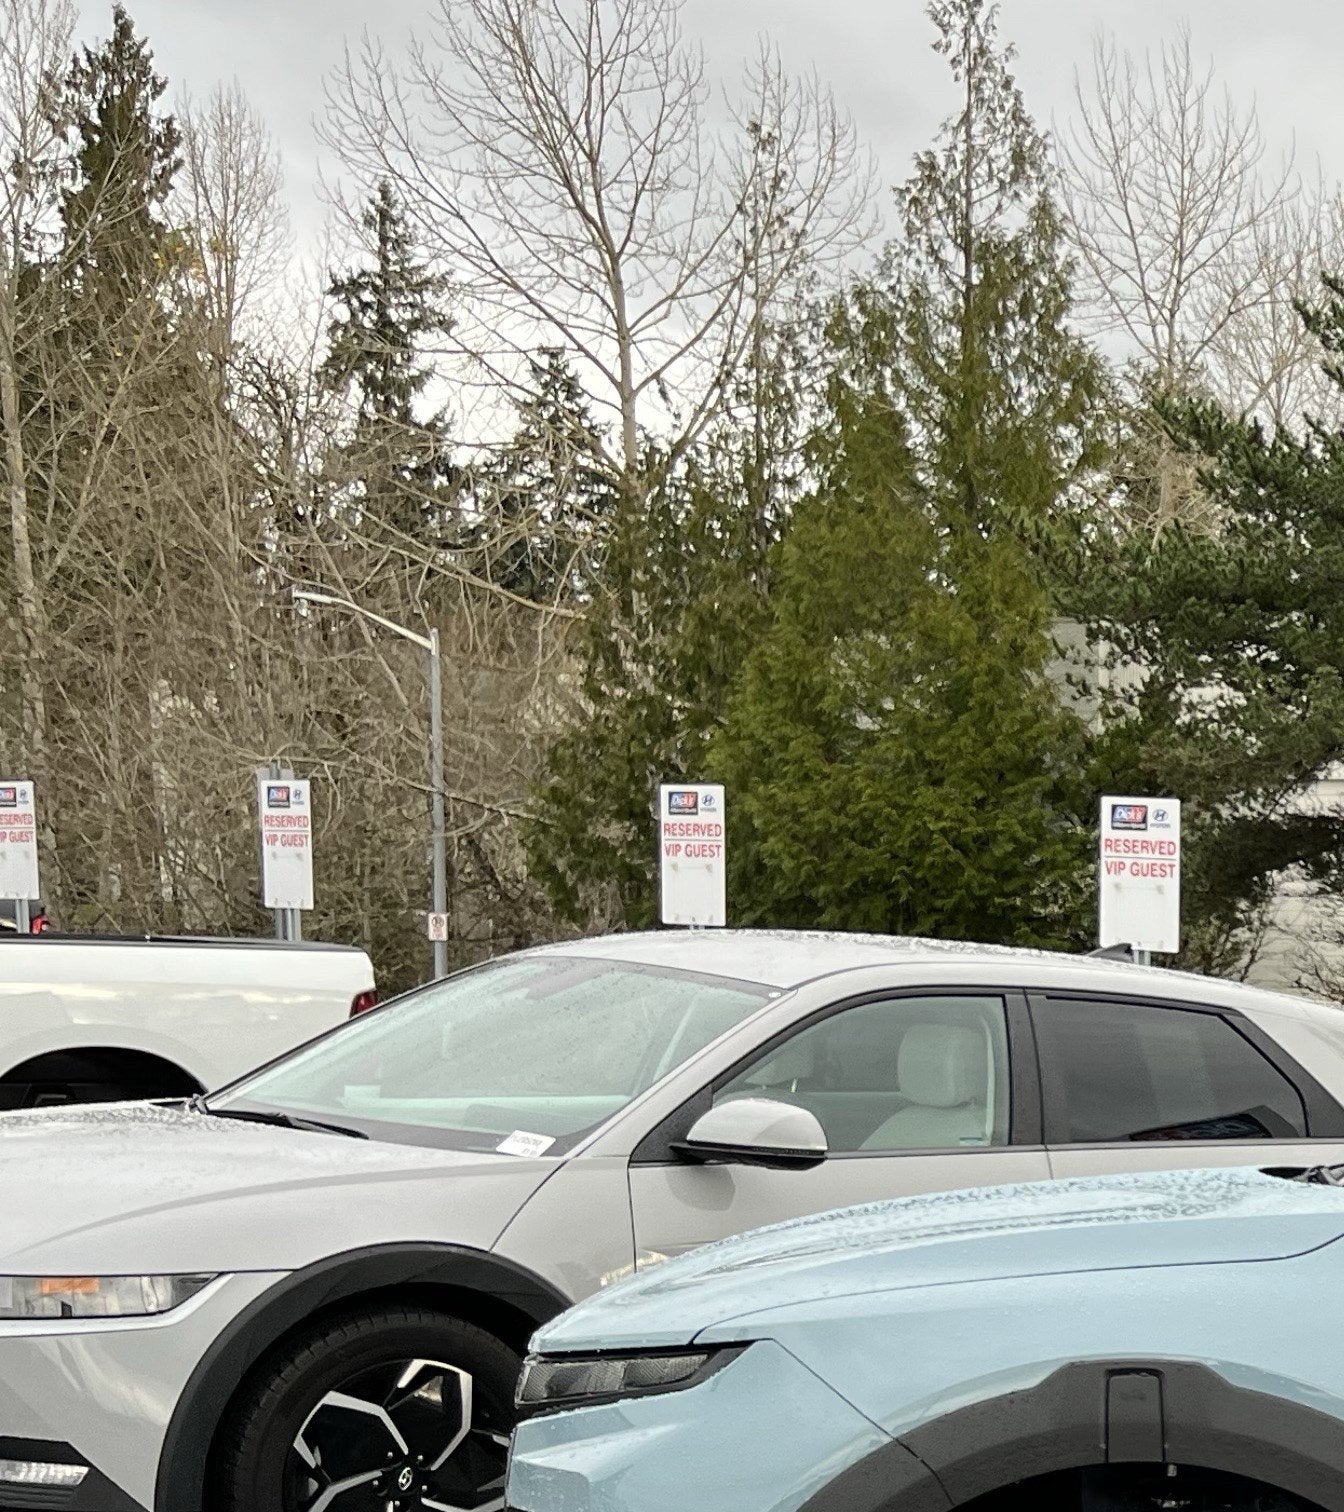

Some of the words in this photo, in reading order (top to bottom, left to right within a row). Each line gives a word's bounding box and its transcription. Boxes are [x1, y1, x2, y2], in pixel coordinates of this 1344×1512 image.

[264, 814, 309, 828] RESERVED
[664, 823, 721, 837] RESERVED
[265, 833, 278, 847] VIP
[280, 834, 309, 848] GUEST
[1104, 838, 1176, 855] RESERVED
[665, 844, 681, 857] VIP
[685, 844, 721, 858] GUEST
[1105, 860, 1126, 876] VIP
[1130, 861, 1176, 877] GUEST
